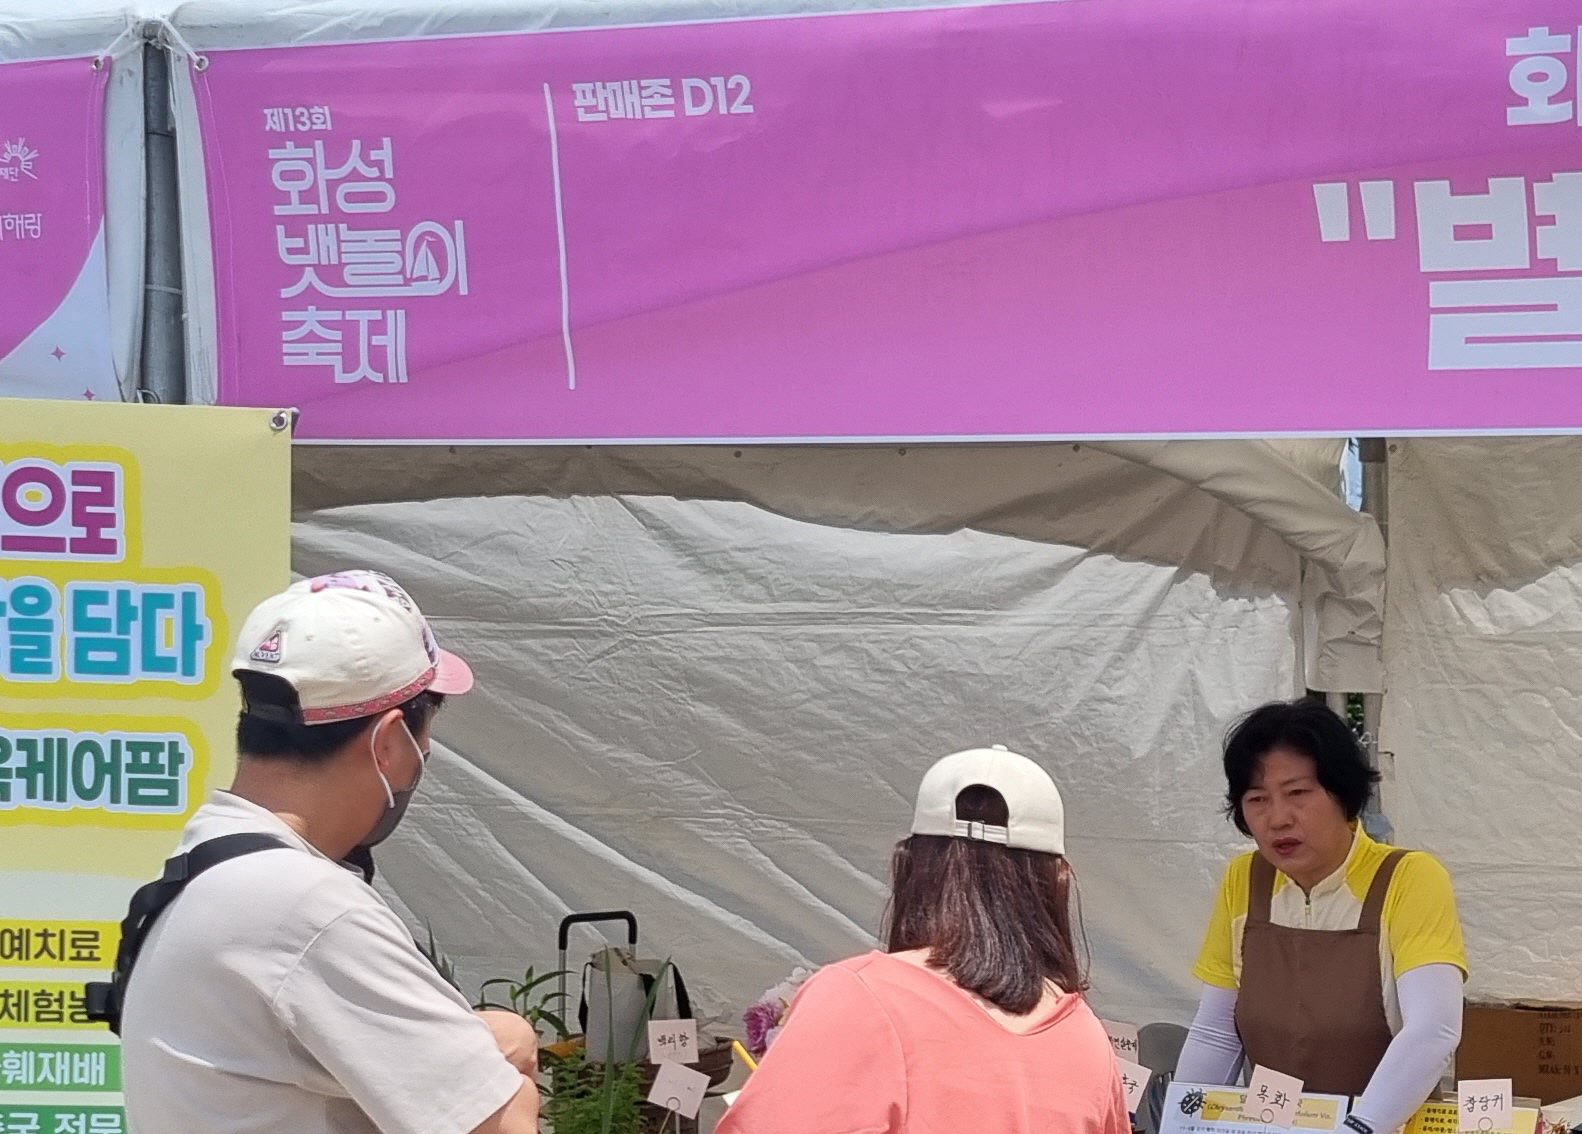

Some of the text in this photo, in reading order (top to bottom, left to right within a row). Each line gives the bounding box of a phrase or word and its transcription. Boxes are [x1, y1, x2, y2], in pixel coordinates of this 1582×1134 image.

[262, 105, 332, 133] 제13회
[572, 74, 755, 122] 판매존 D12
[266, 137, 397, 216] 화성
[0, 212, 43, 240] 해랑
[275, 219, 469, 299] 뱃놀이
[281, 306, 409, 385] 축제
[0, 584, 205, 677] 을 담다
[0, 1050, 106, 1087] 훼재배
[1256, 1083, 1291, 1110] 목화
